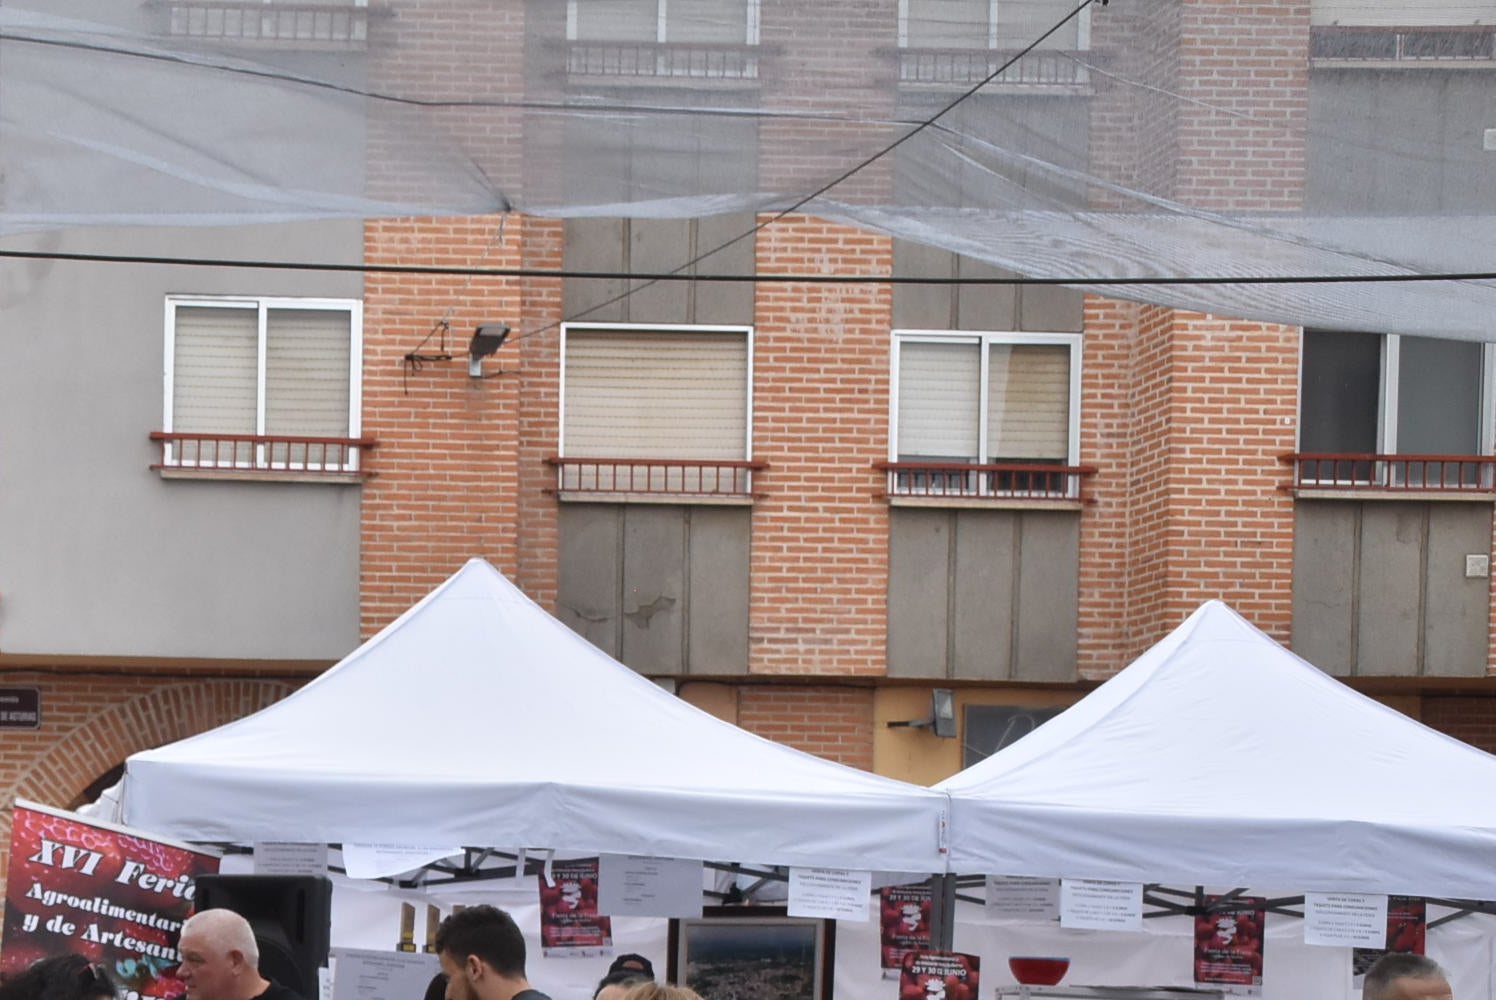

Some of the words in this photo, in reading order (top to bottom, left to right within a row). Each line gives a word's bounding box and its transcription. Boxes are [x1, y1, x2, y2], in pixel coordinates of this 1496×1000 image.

[28, 838, 104, 876] XVI
[25, 882, 187, 934] Agroalimentar
[22, 913, 39, 933] y
[46, 914, 76, 936] de
[912, 966, 920, 974] 29
[928, 967, 936, 975] 30
[944, 968, 967, 976] JUNIO
